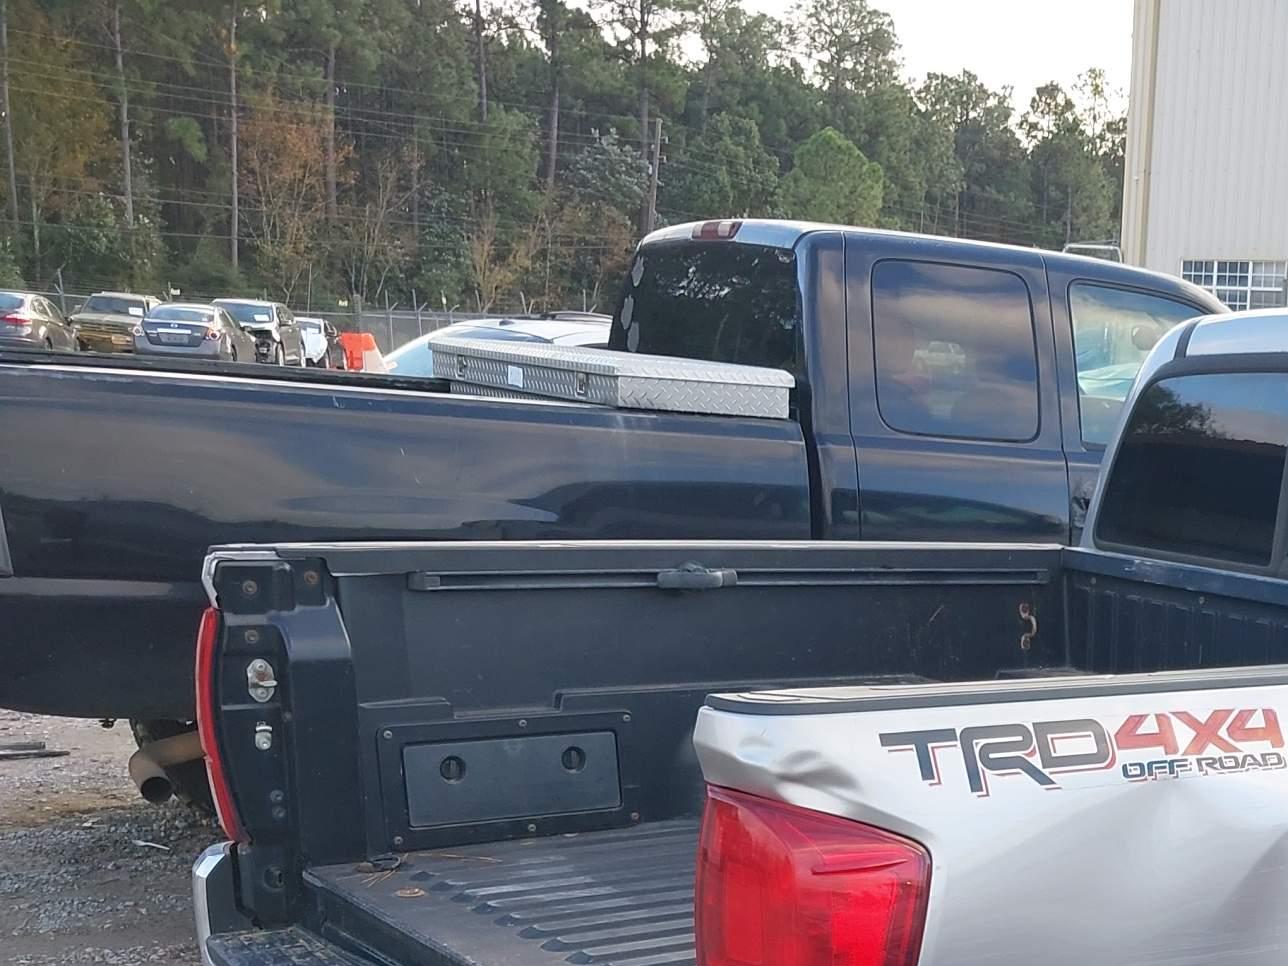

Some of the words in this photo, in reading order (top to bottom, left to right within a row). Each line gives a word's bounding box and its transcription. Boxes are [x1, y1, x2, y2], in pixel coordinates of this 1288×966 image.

[879, 718, 1117, 798] TRD
[1114, 708, 1285, 756] 4X4
[1121, 758, 1193, 783] OFF
[1196, 751, 1288, 776] ROAD
